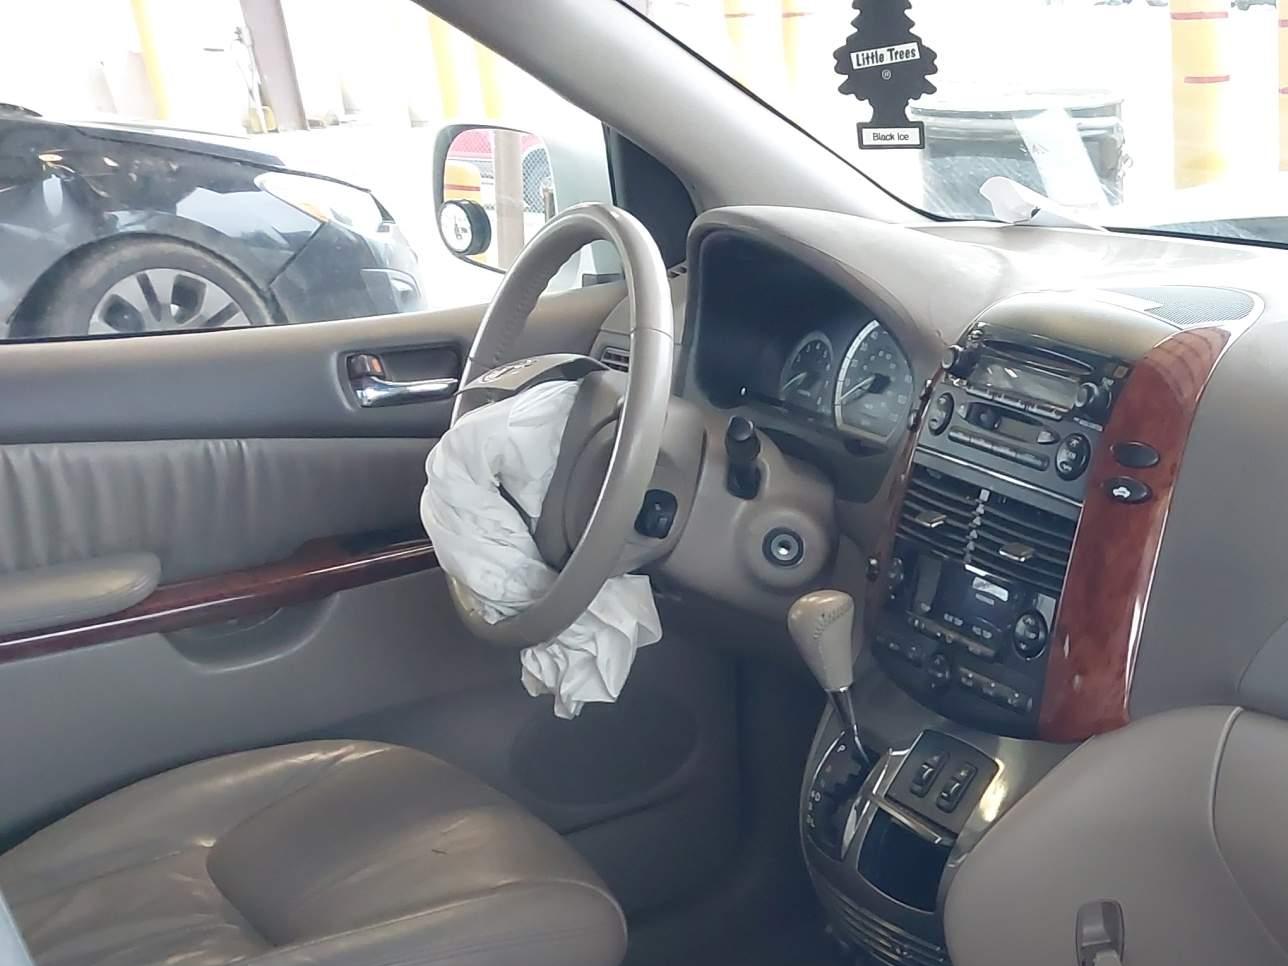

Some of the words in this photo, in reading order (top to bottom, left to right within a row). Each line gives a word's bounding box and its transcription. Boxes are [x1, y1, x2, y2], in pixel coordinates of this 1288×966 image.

[855, 50, 884, 67] Little
[887, 47, 916, 62] Trees
[872, 132, 895, 141] Black
